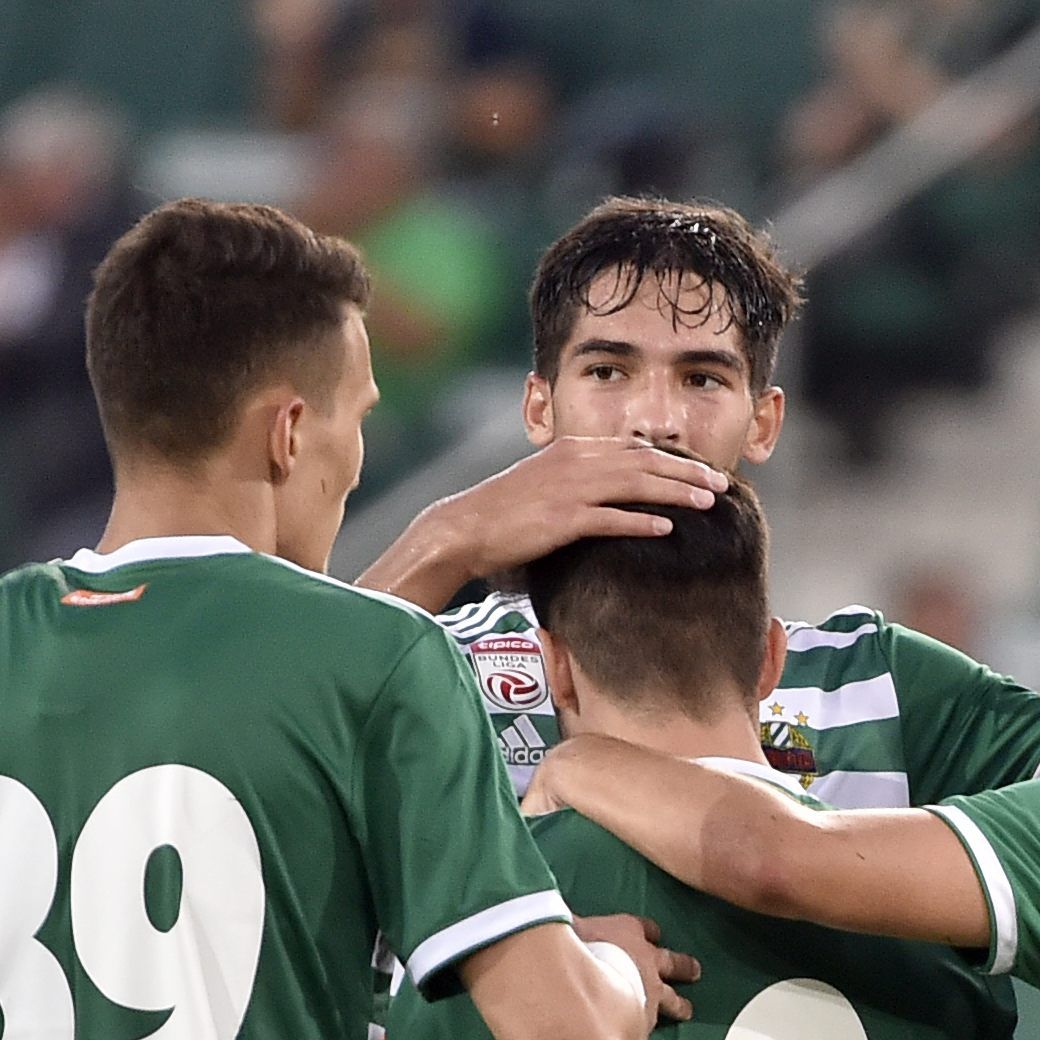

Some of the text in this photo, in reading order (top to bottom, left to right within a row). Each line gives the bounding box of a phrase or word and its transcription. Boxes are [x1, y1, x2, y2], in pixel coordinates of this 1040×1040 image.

[478, 640, 534, 650] tipico
[478, 655, 539, 664] BUNDES
[492, 661, 527, 669] LIGA
